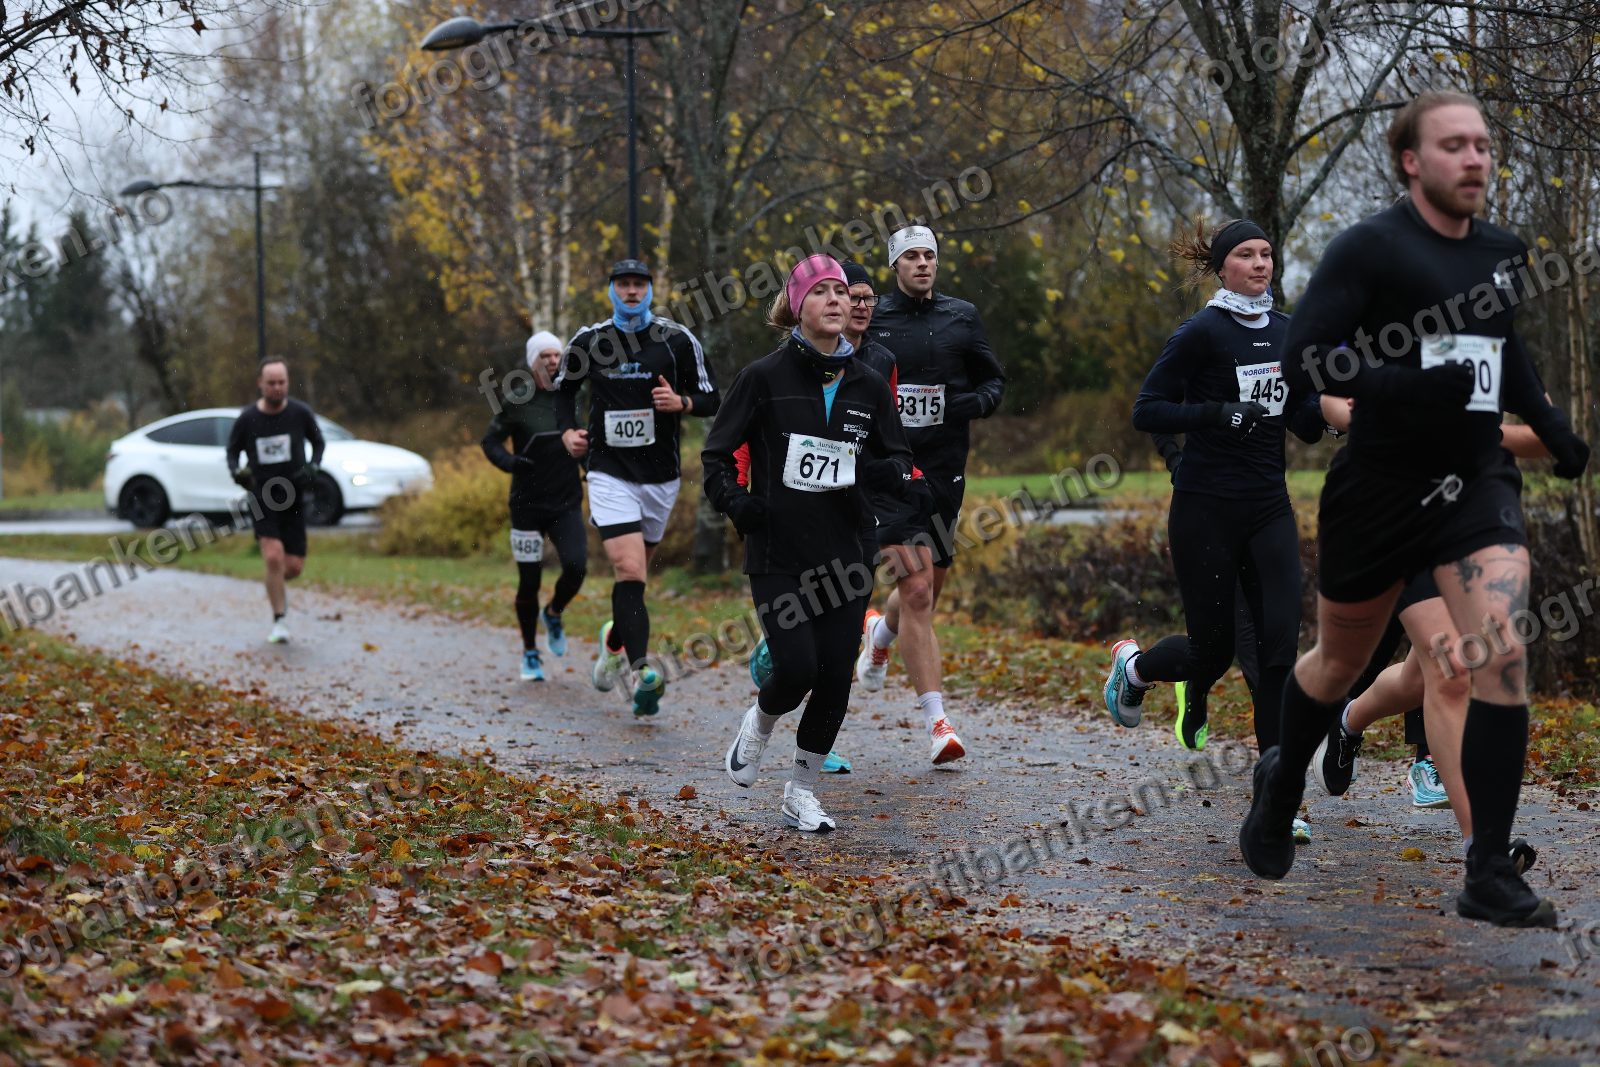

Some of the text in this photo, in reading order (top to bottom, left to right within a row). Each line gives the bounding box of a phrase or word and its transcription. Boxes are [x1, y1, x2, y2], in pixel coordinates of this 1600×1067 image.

[1250, 377, 1285, 403] 445
[614, 419, 645, 438] 402
[799, 453, 840, 484] 671
